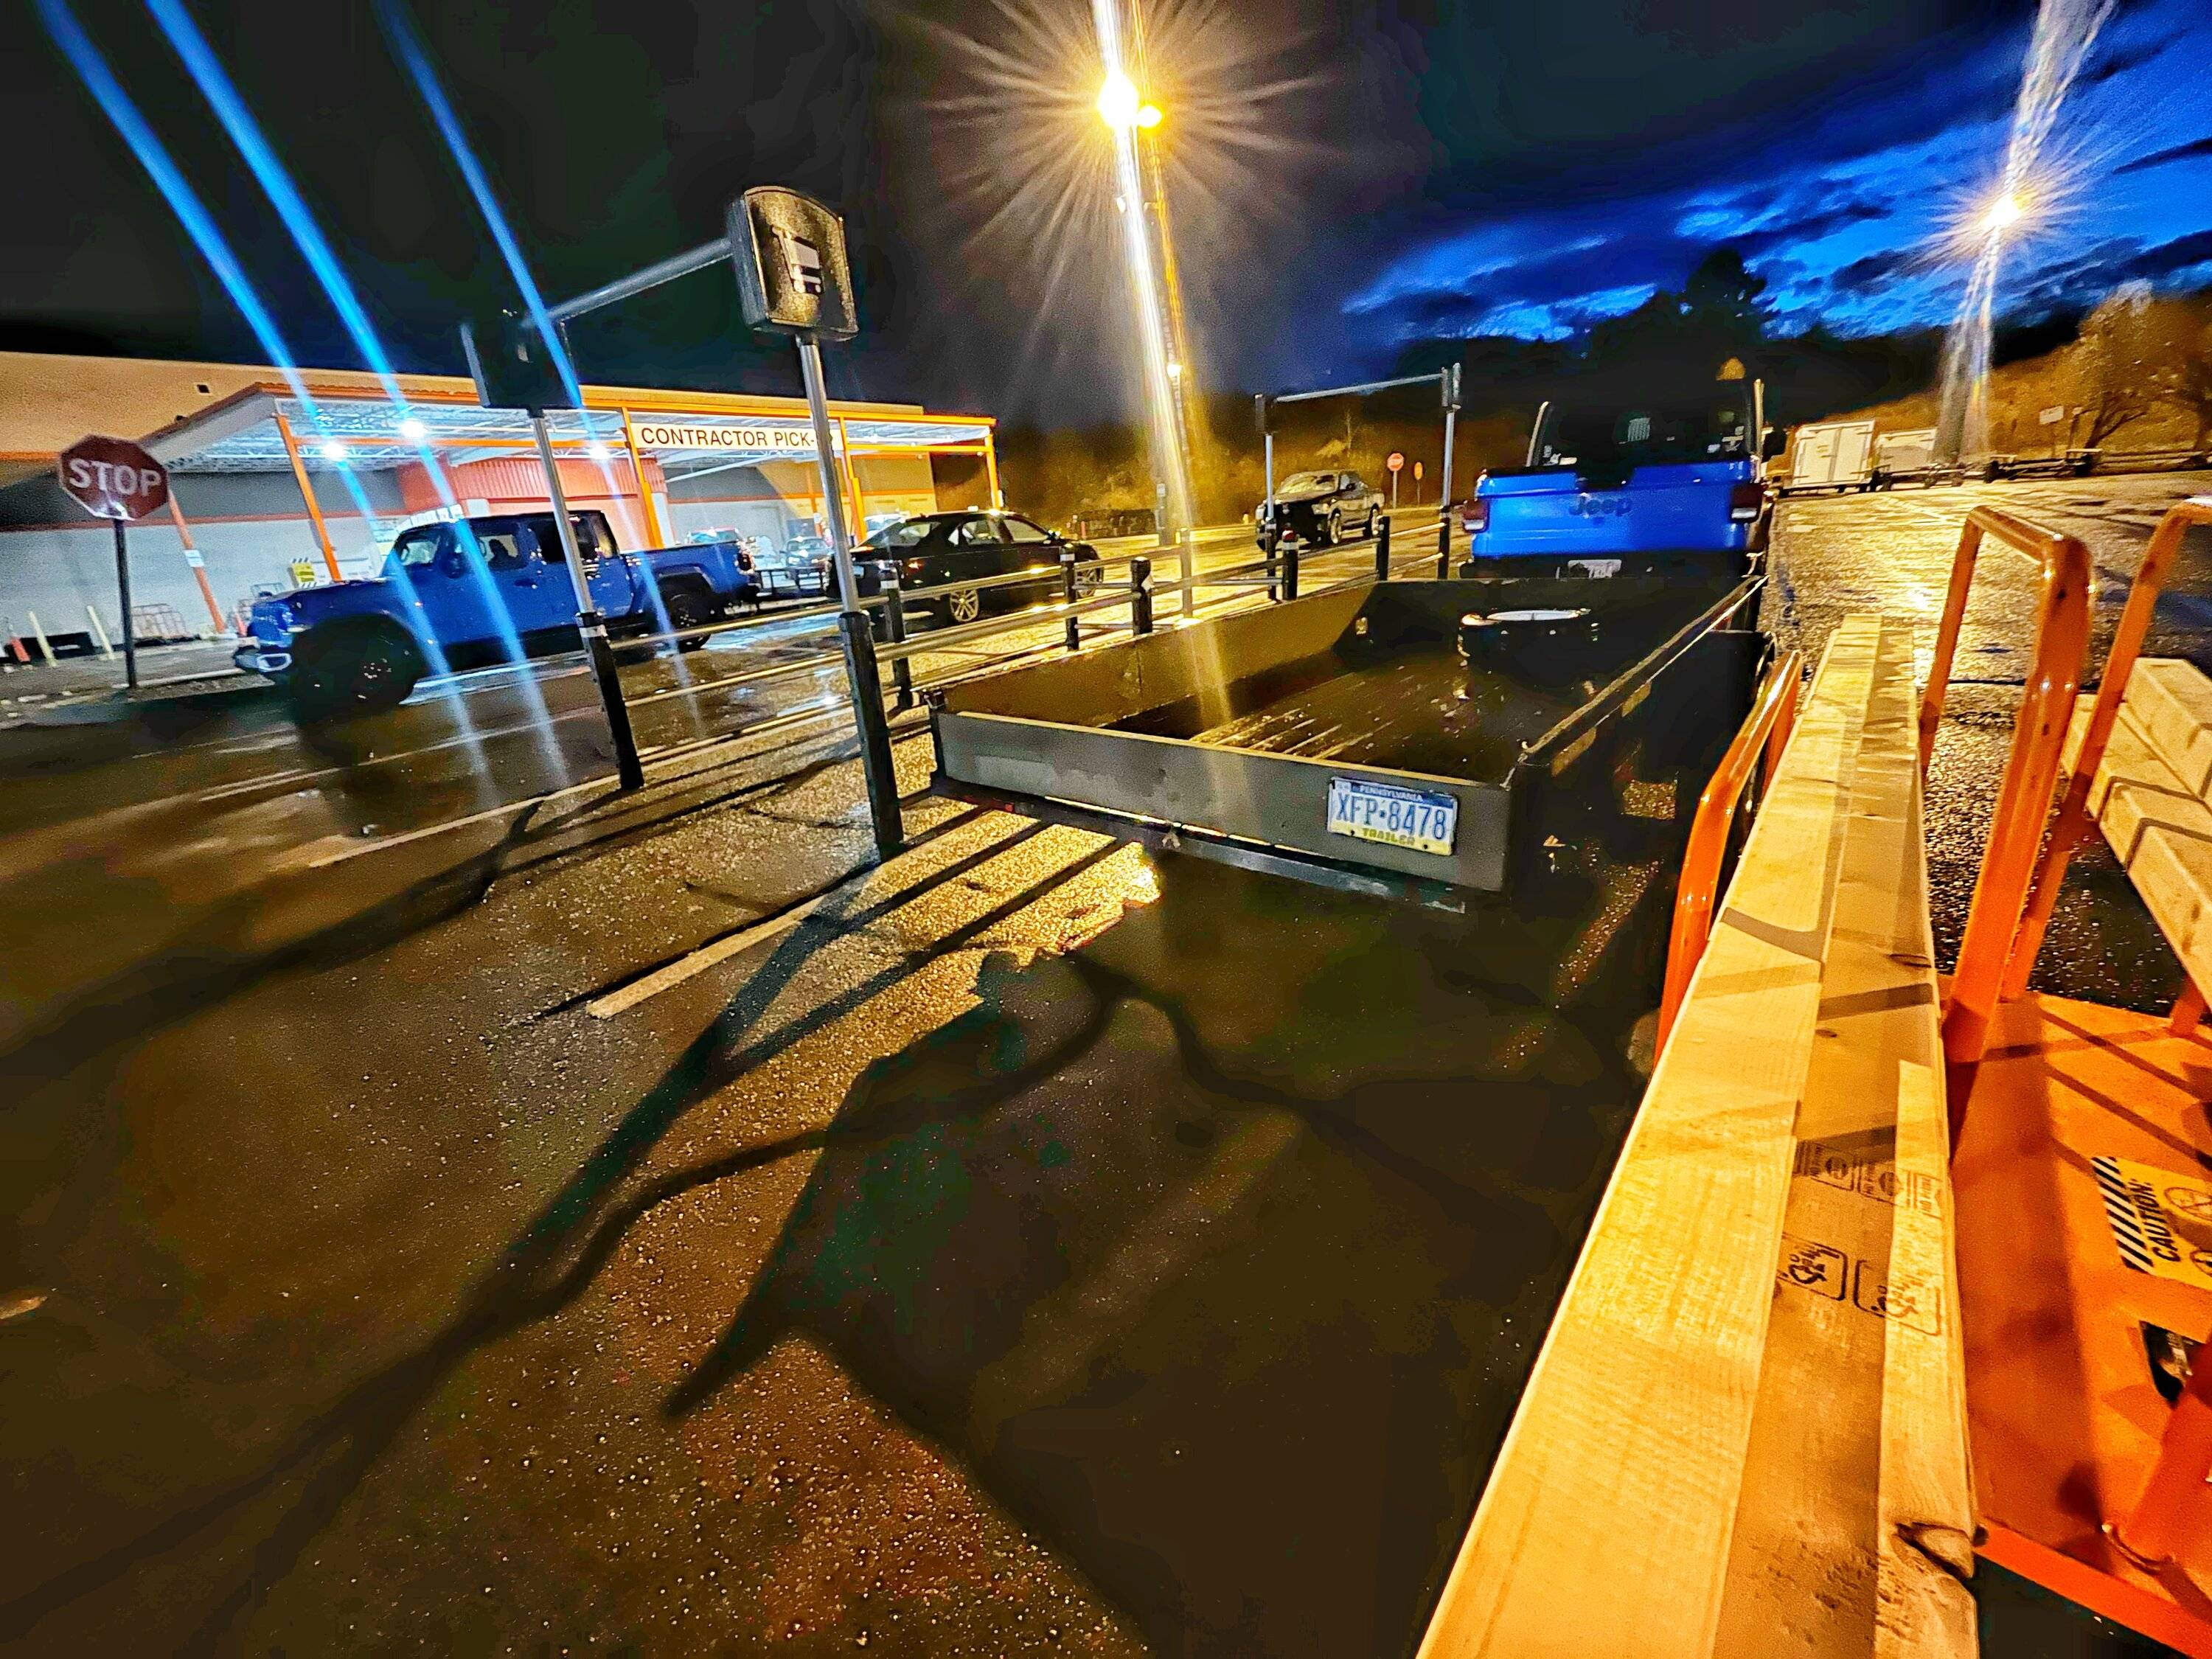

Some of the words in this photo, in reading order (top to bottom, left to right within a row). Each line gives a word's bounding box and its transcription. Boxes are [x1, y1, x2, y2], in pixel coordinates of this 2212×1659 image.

[641, 427, 768, 447] CONTRACTOR
[69, 458, 161, 496] STOP
[1568, 496, 1632, 517] Jeep
[1363, 827, 1416, 846] TRAILER
